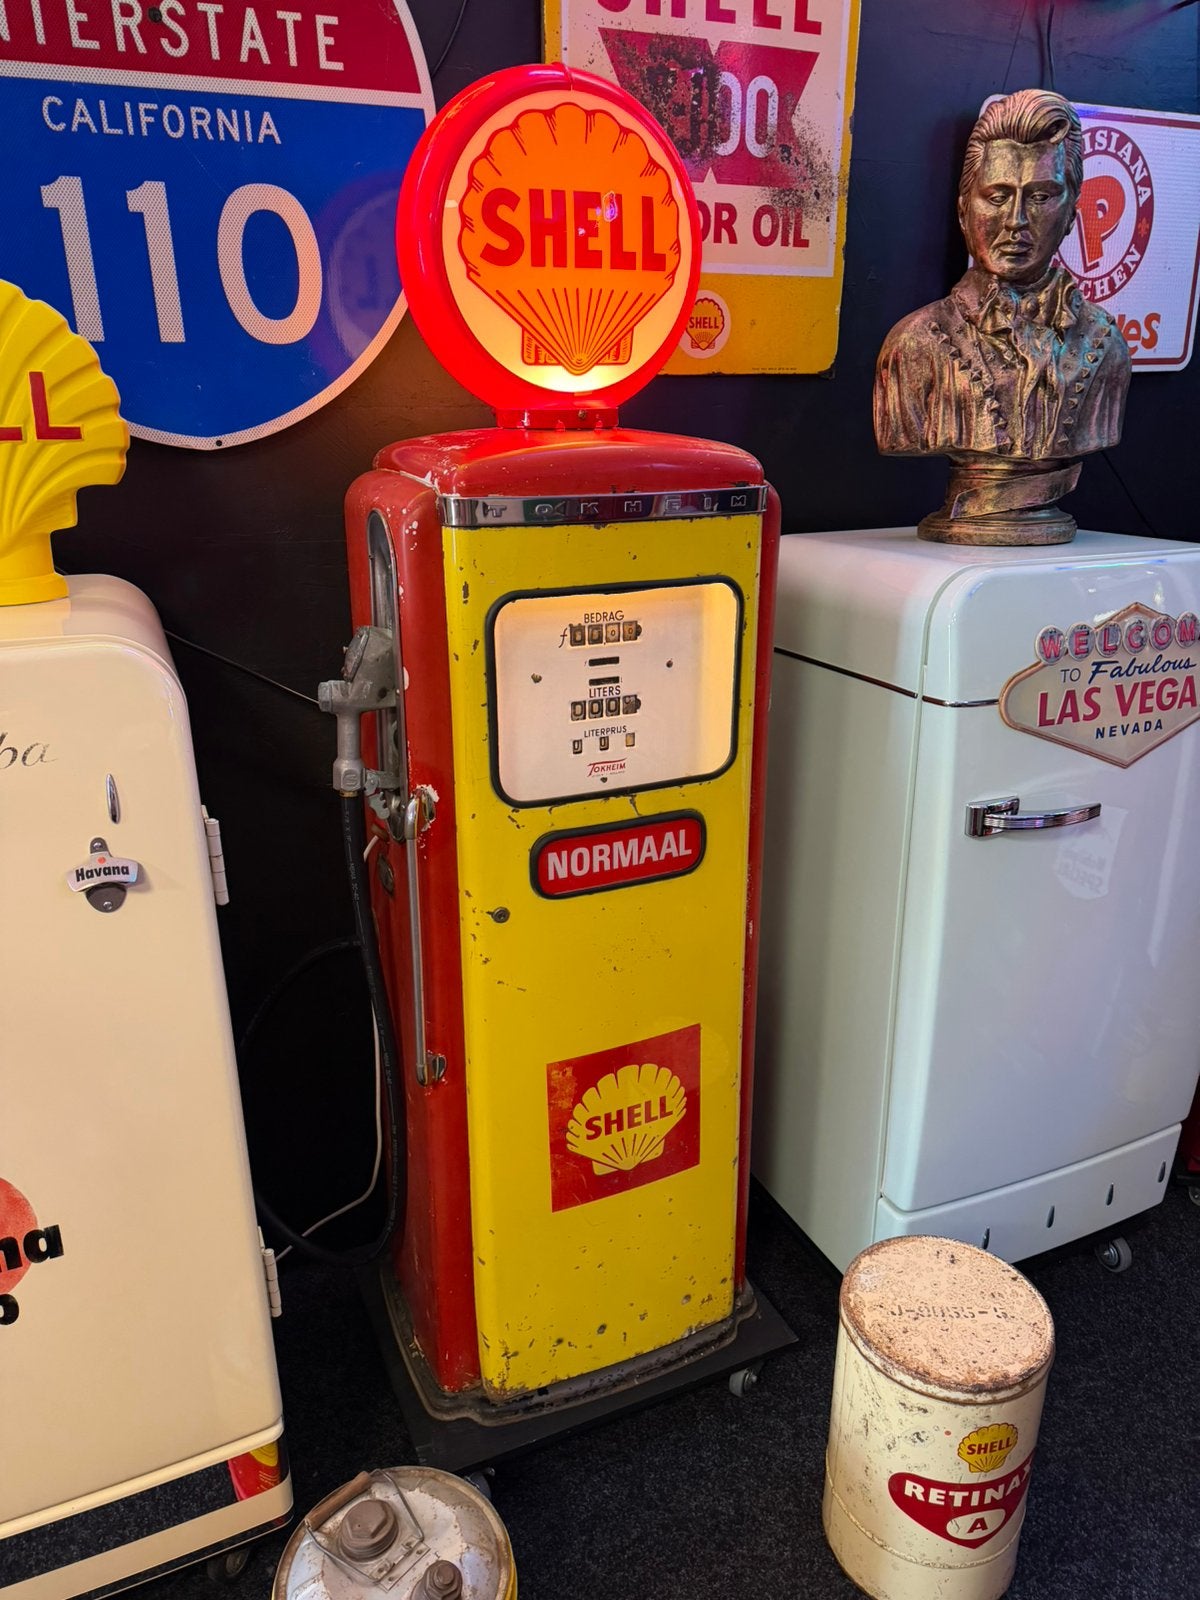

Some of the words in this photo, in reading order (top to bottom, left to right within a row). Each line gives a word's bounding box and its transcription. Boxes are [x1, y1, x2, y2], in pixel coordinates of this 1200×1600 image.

[42, 96, 282, 145] CALIFORNIA
[1082, 128, 1152, 207] ISIANA
[480, 186, 667, 272] SHELL
[753, 203, 810, 248] OIL
[40, 175, 323, 345] 110
[1080, 243, 1142, 300] CHEN
[688, 316, 720, 330] SHELL
[584, 610, 625, 624] BEDRAG
[1060, 667, 1082, 683] TO
[1088, 653, 1198, 685] Fabulous
[588, 685, 622, 699] LITERS
[1038, 686, 1103, 728] LAS
[1095, 718, 1164, 740] NEVADA
[586, 757, 628, 778] TOKHEIM
[75, 863, 130, 883] Havana
[547, 828, 693, 882] NORMAAL
[585, 1095, 674, 1142] SHELL
[966, 1438, 1013, 1456] SHELL
[966, 1516, 989, 1534] A
